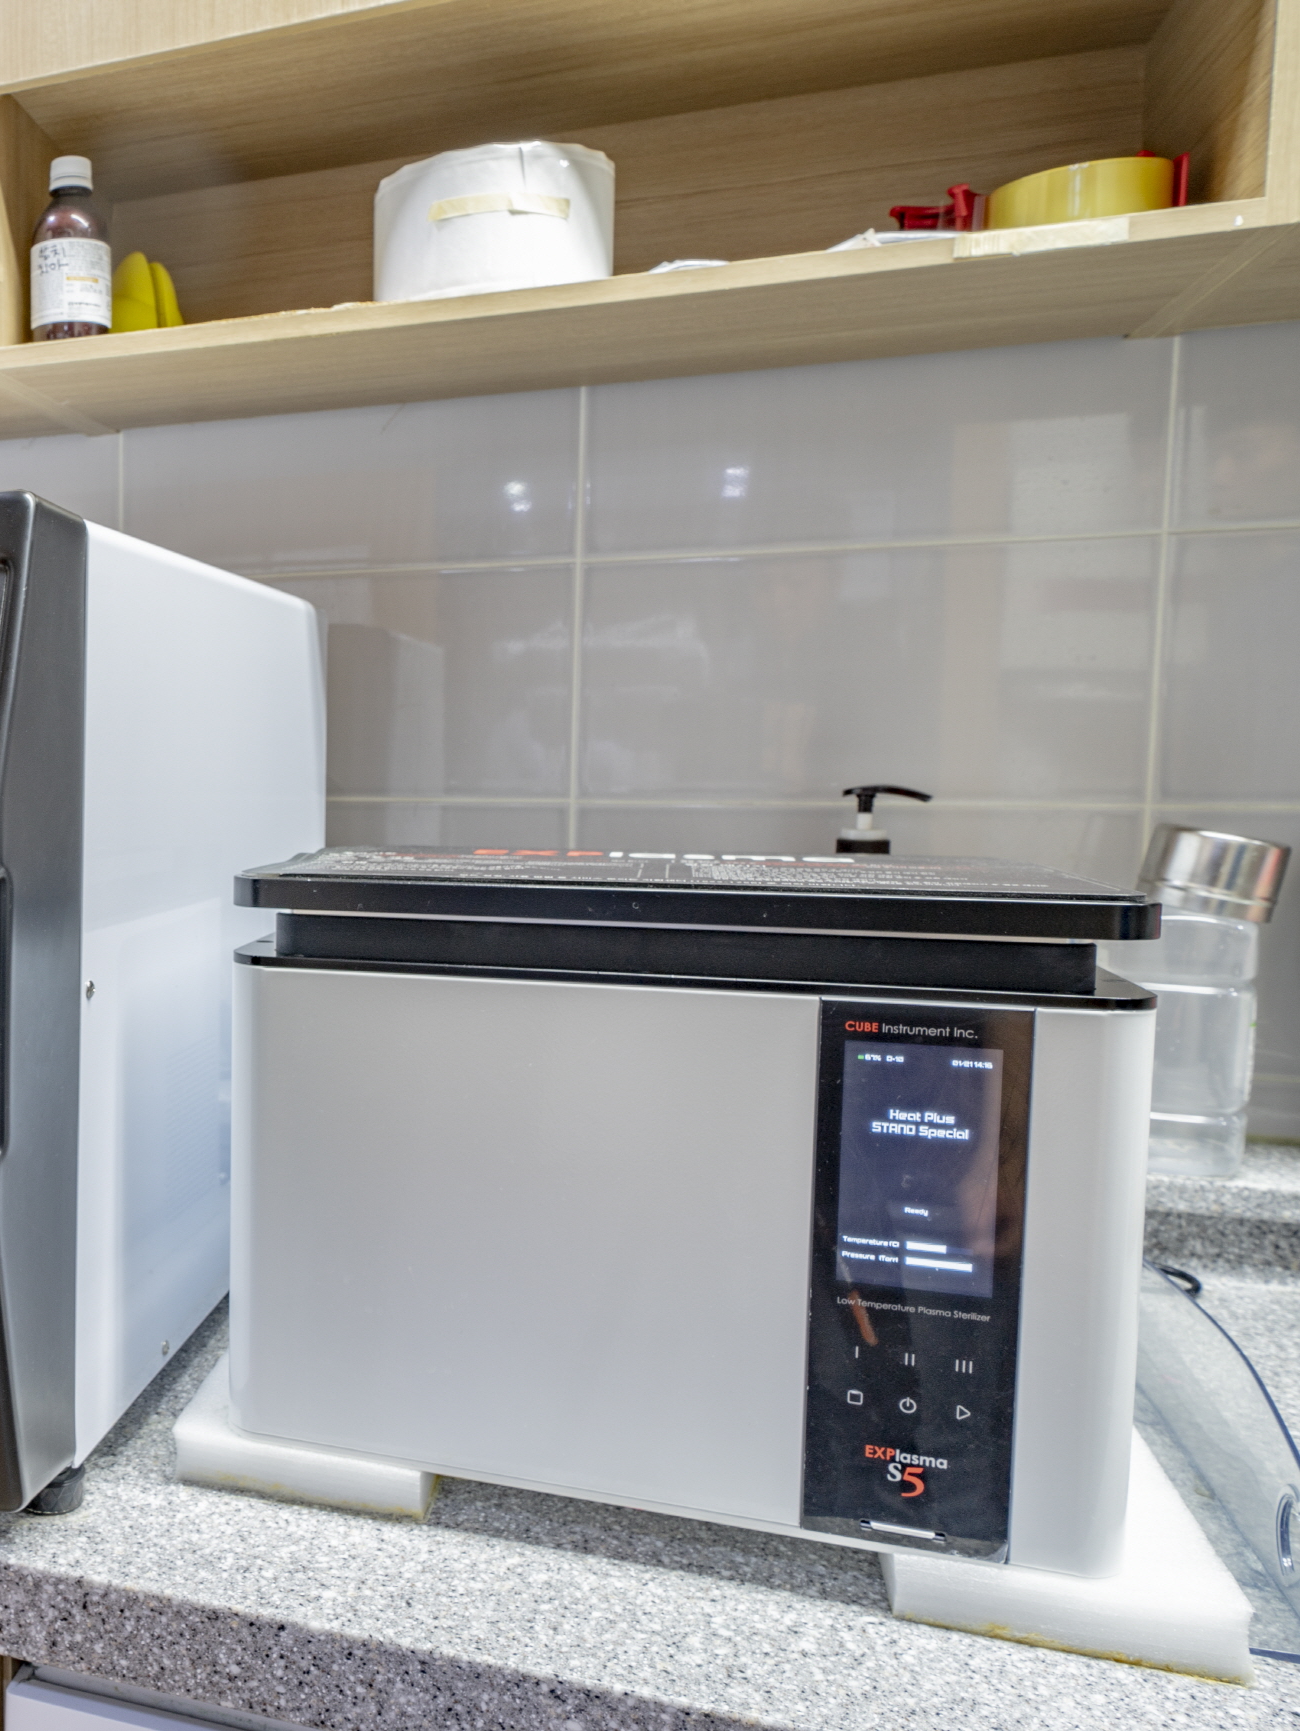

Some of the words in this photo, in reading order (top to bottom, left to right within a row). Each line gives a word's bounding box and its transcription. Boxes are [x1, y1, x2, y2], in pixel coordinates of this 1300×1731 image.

[845, 1020, 879, 1033] CUBE
[882, 1022, 950, 1037] Instrument
[954, 1027, 978, 1039] Inc.
[889, 1109, 921, 1122] Heat
[924, 1112, 955, 1125] Plus
[919, 1126, 969, 1140] Special
[904, 1206, 928, 1217] Ready
[837, 1296, 855, 1305] Low
[857, 1298, 915, 1313] Temperature
[918, 1306, 951, 1317] Plasma
[954, 1310, 991, 1322] Sterilizer
[865, 1444, 948, 1470] EXPlasma
[887, 1462, 925, 1497] S5
